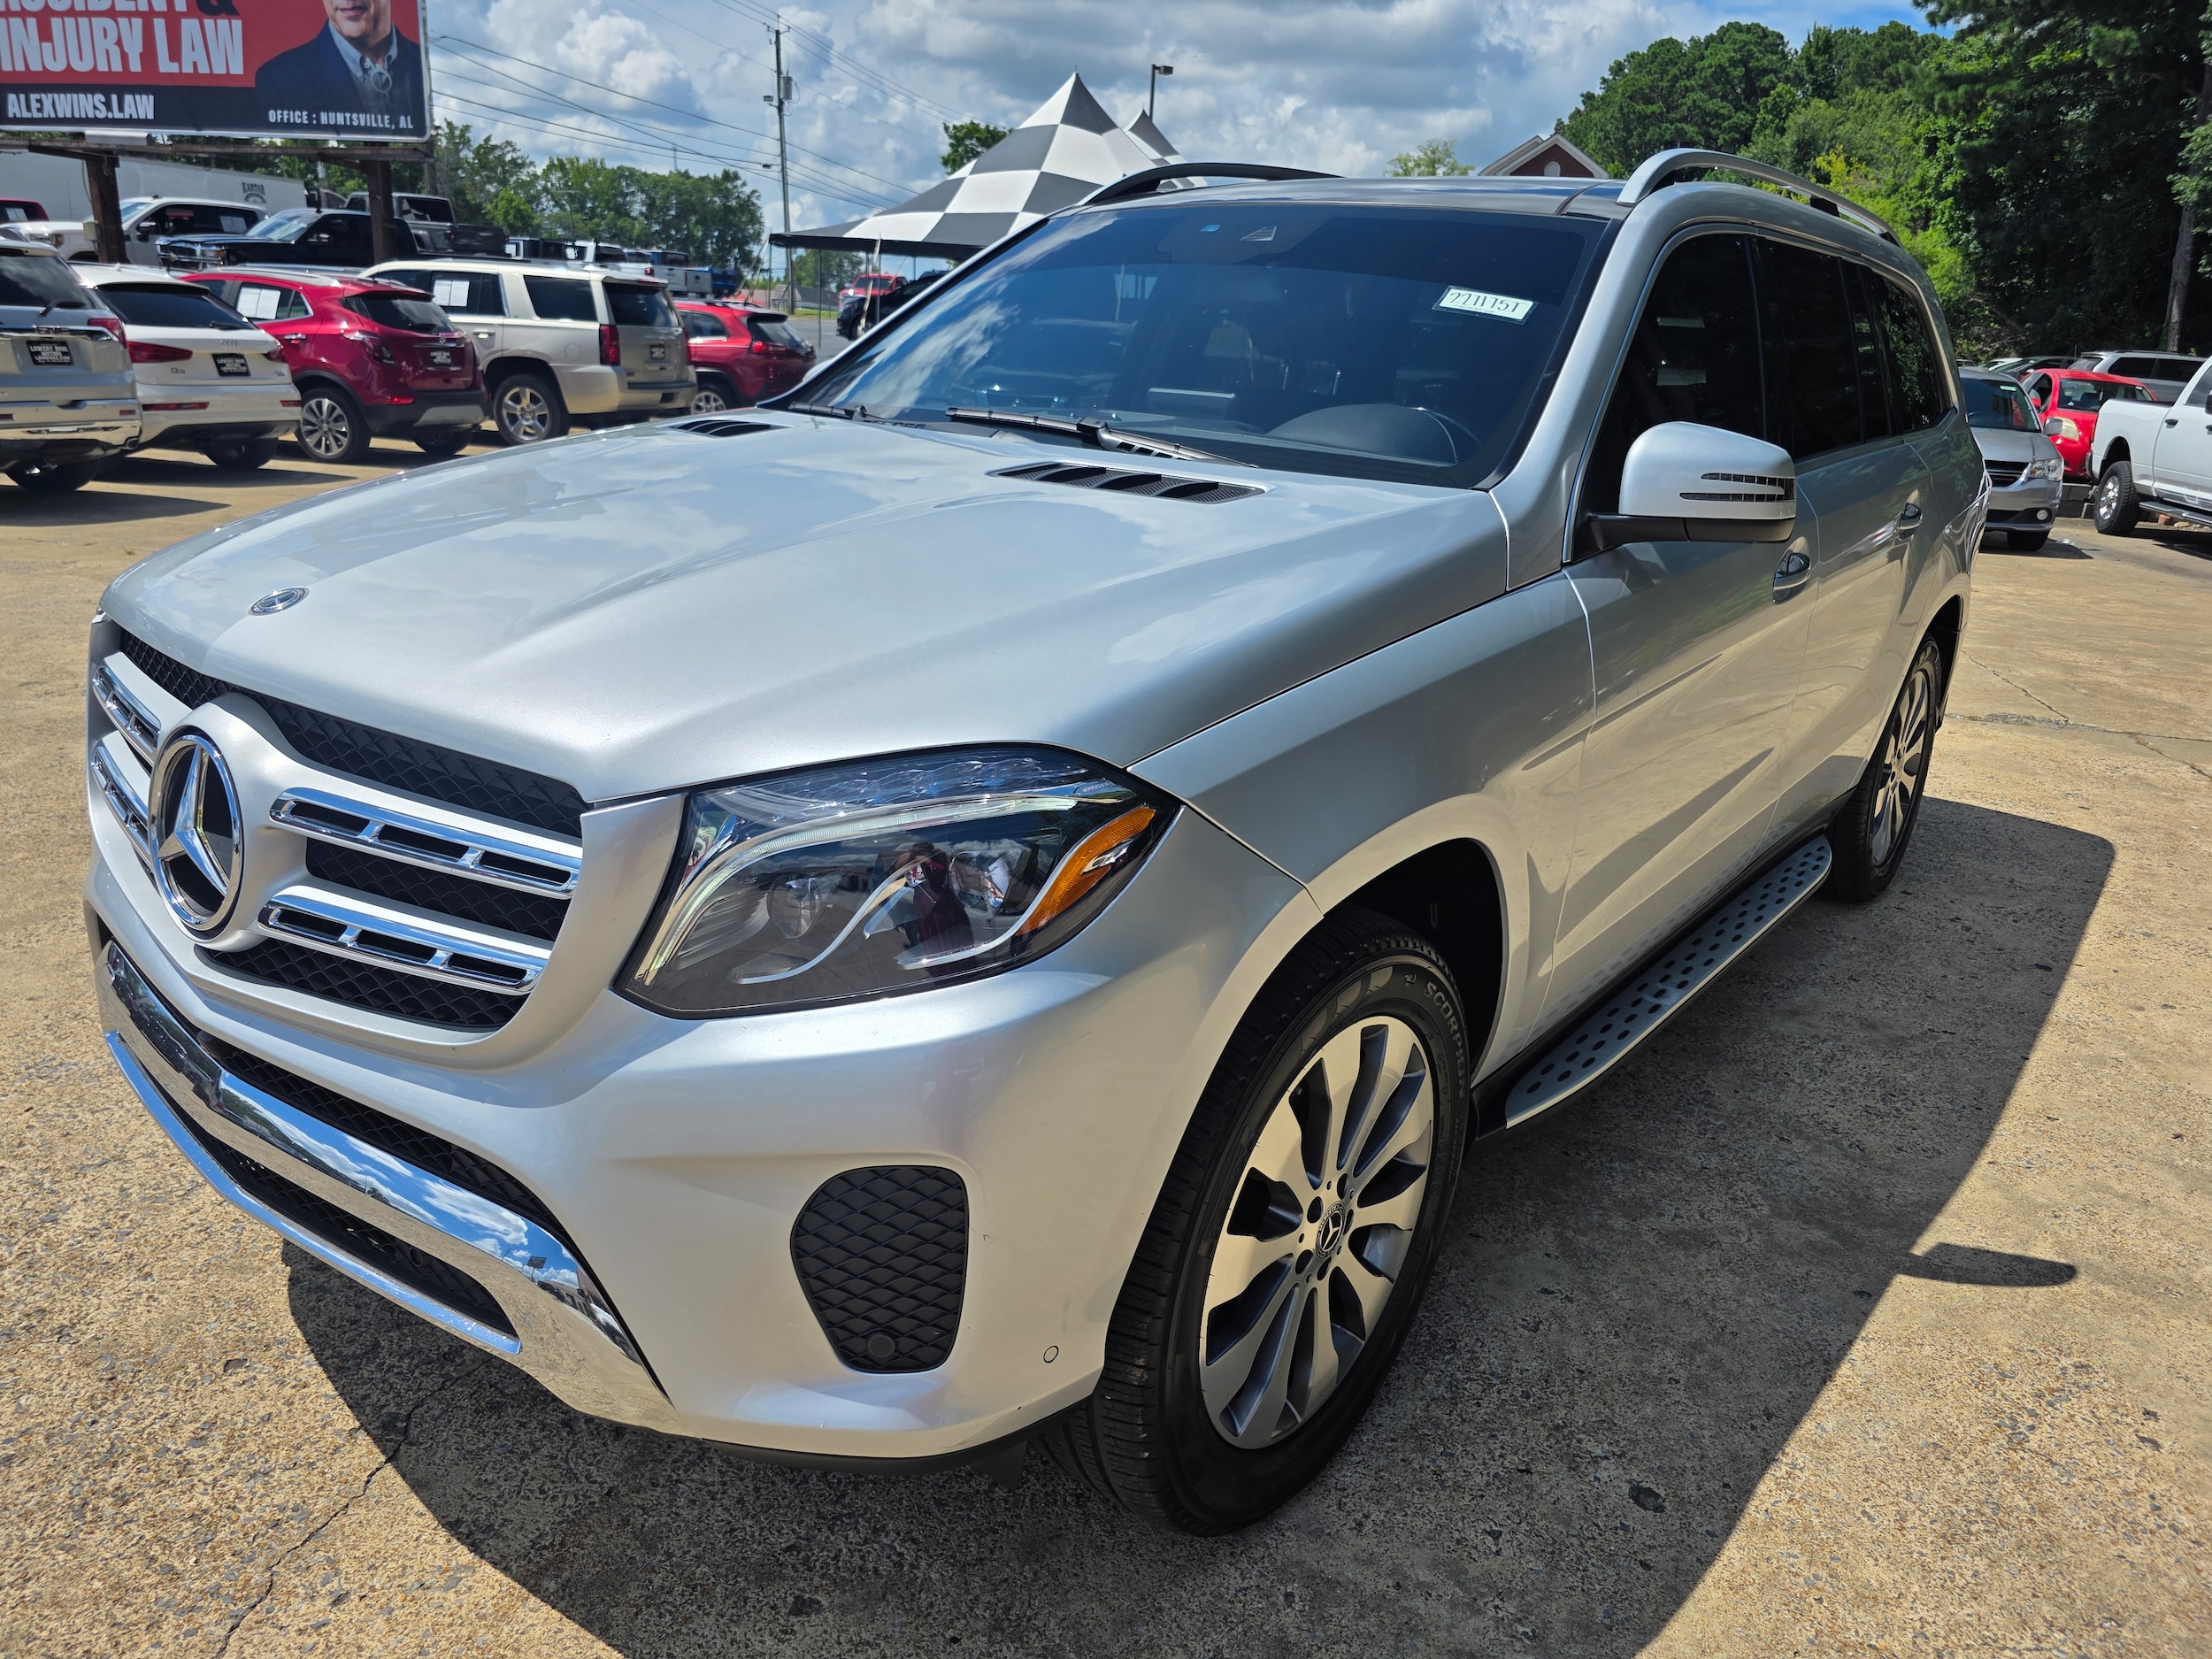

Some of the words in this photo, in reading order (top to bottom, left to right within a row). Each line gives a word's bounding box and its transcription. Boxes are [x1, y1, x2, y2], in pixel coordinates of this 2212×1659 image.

[0, 17, 143, 72] INJURY
[153, 18, 244, 75] LAW
[7, 93, 155, 120] ALEXWINS.LAW
[268, 110, 309, 124] OFFICE
[320, 111, 396, 130] HUNTSVILLE,
[399, 116, 414, 129] AL
[1423, 981, 1466, 1098] SCORPION
